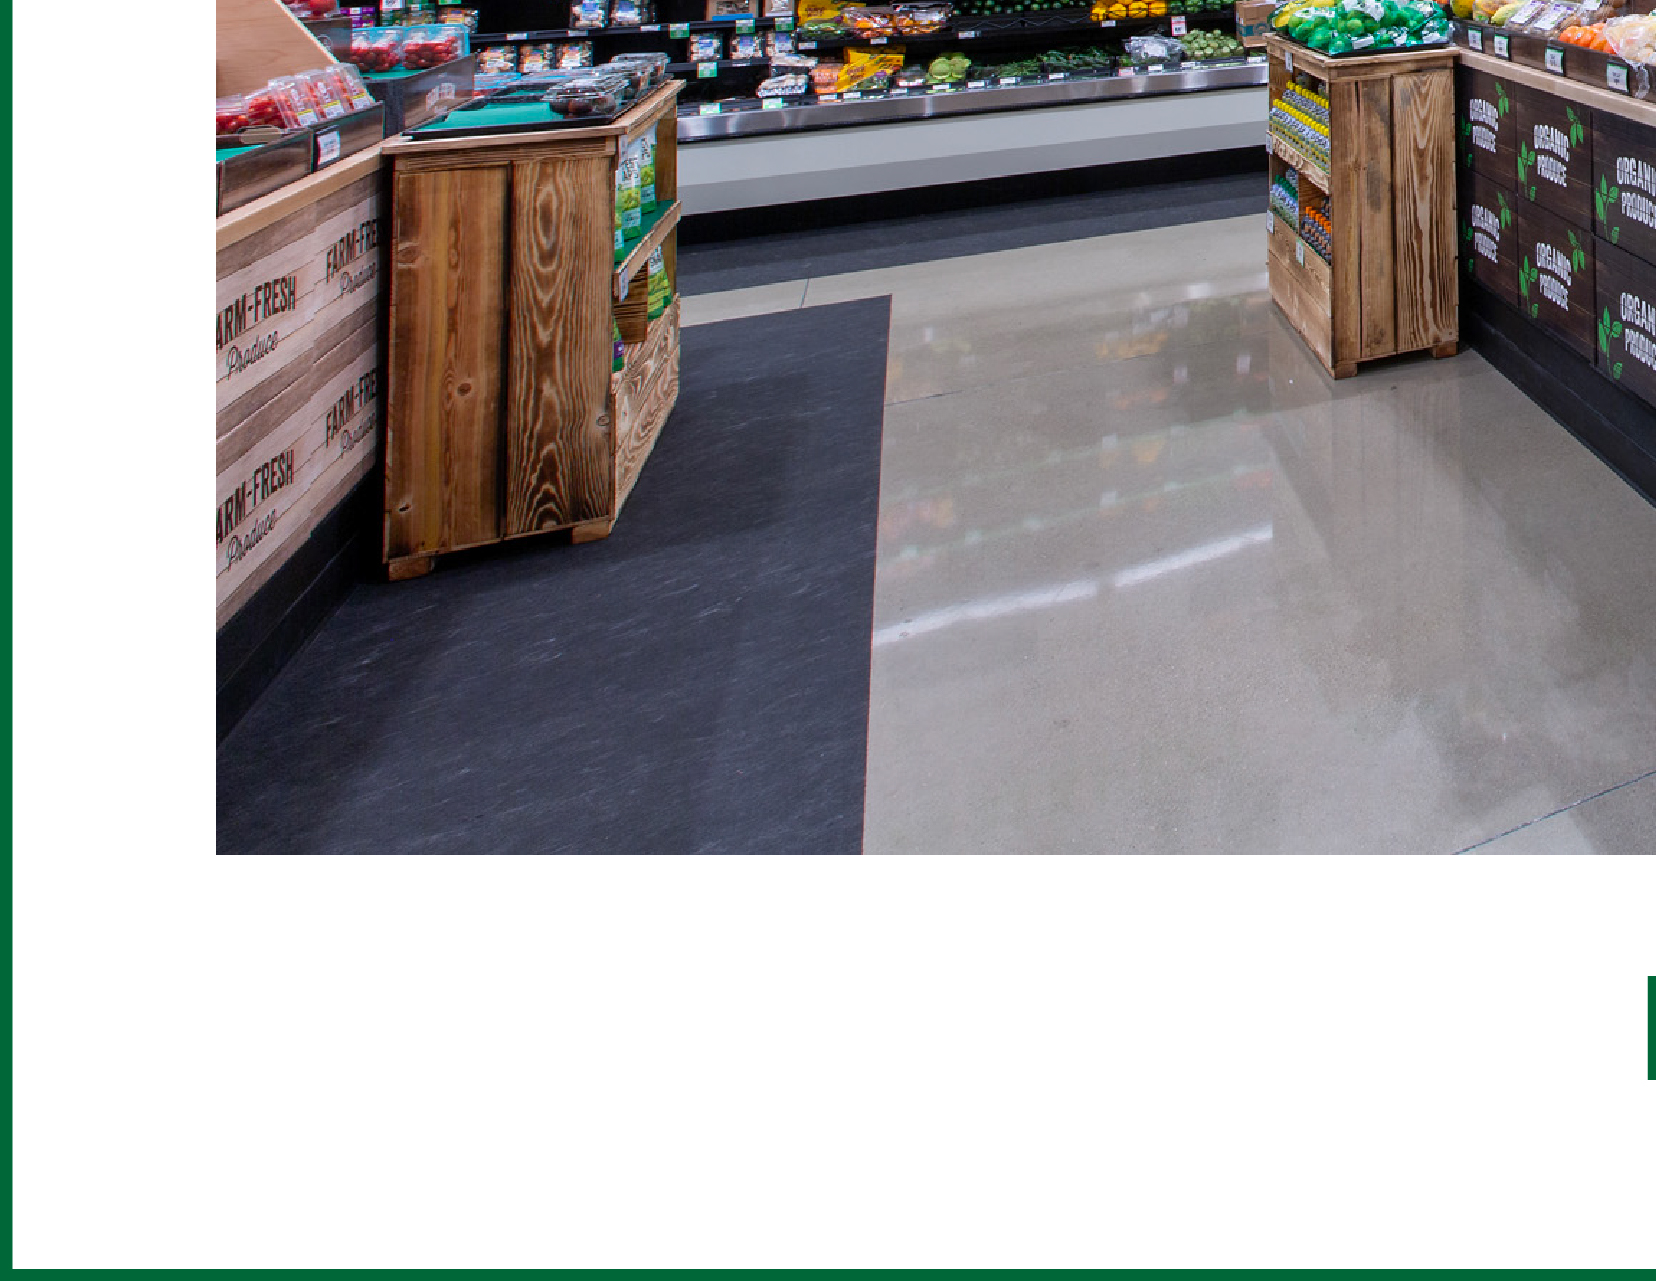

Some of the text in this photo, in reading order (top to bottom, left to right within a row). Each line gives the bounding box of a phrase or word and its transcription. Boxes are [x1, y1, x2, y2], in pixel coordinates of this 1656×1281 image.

[1533, 124, 1569, 163] ORGANIC
[1537, 153, 1567, 188] PRODUCE
[1535, 241, 1572, 284] ORGANIC
[1539, 272, 1569, 313] PRODUCE
[226, 330, 279, 381] Produce
[226, 508, 278, 571] Produce
